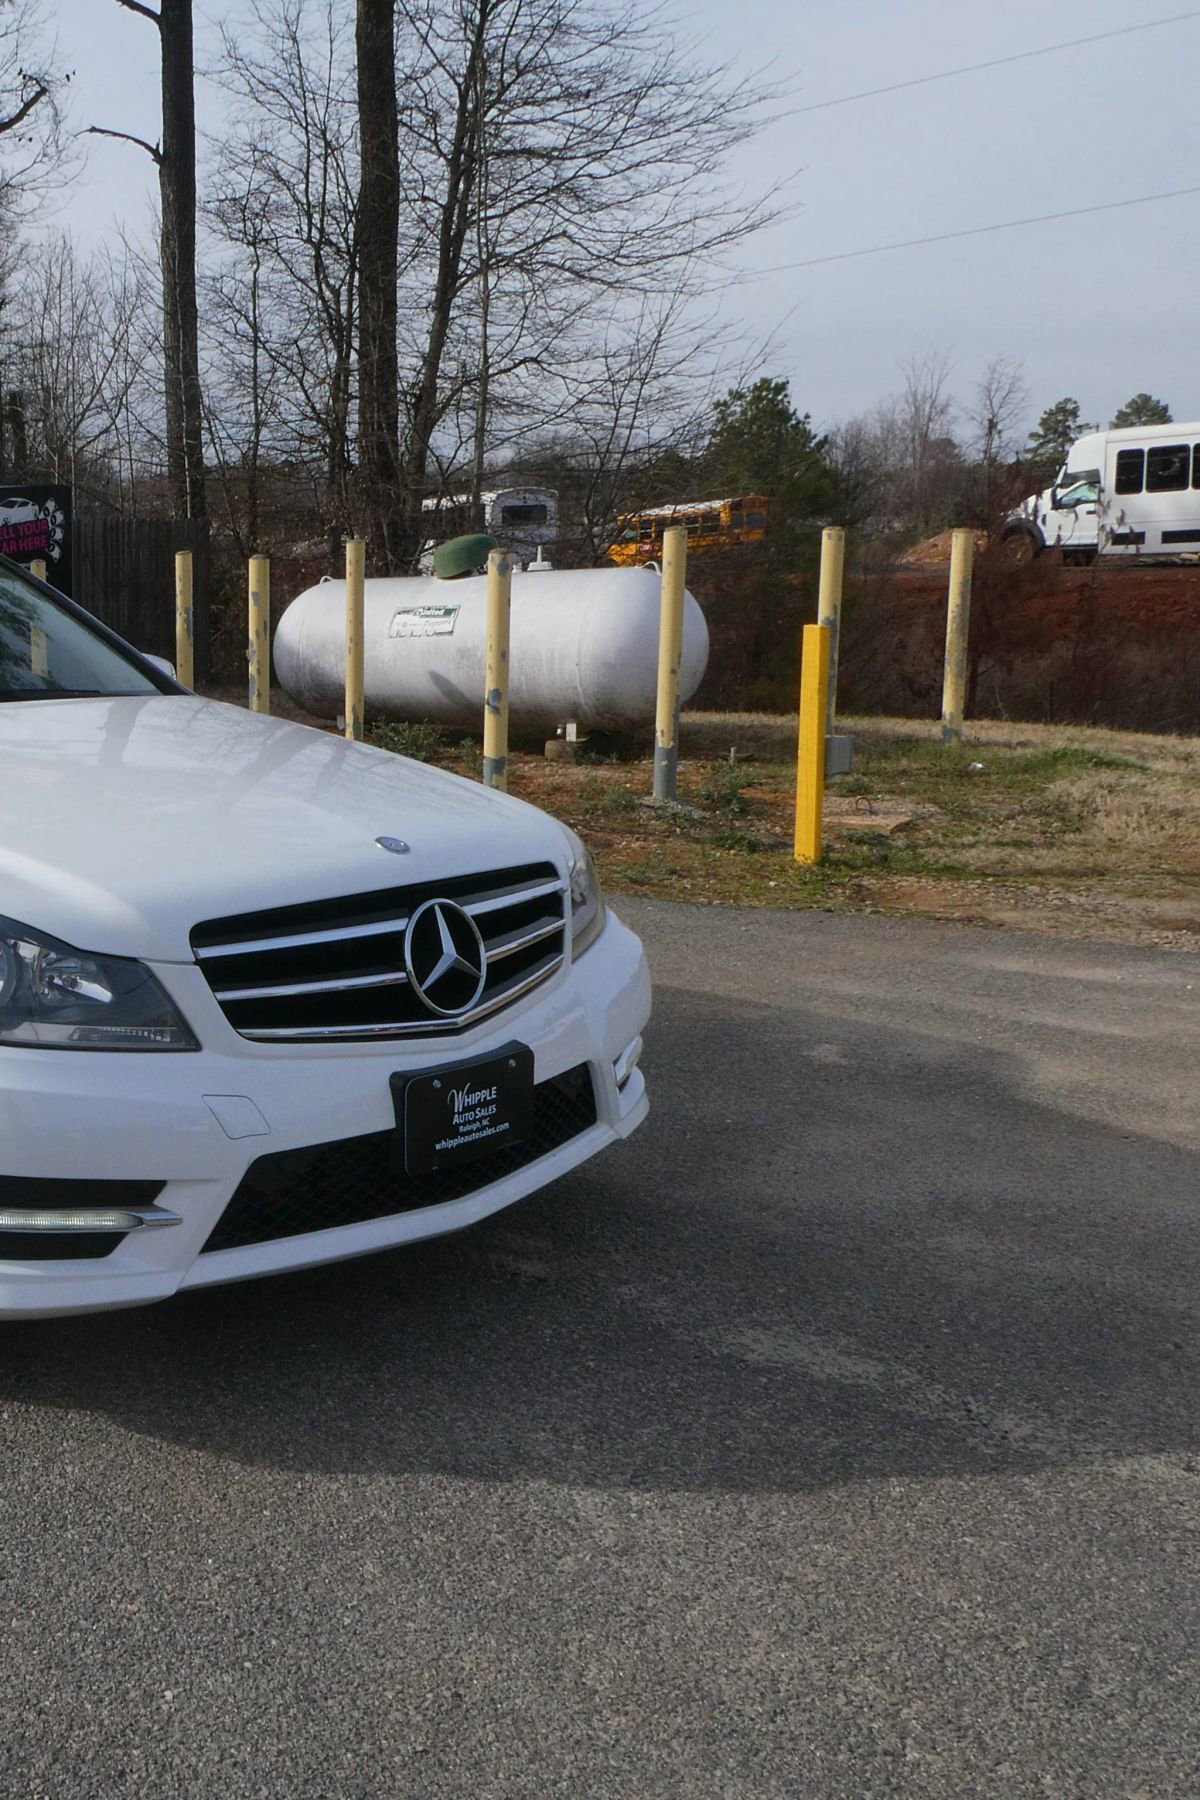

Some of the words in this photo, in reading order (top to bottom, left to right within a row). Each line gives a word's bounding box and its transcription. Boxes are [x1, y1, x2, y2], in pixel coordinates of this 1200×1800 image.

[17, 519, 48, 537] YOUR
[17, 535, 48, 551] HERE
[435, 1122, 510, 1150] whippleautosales.com
